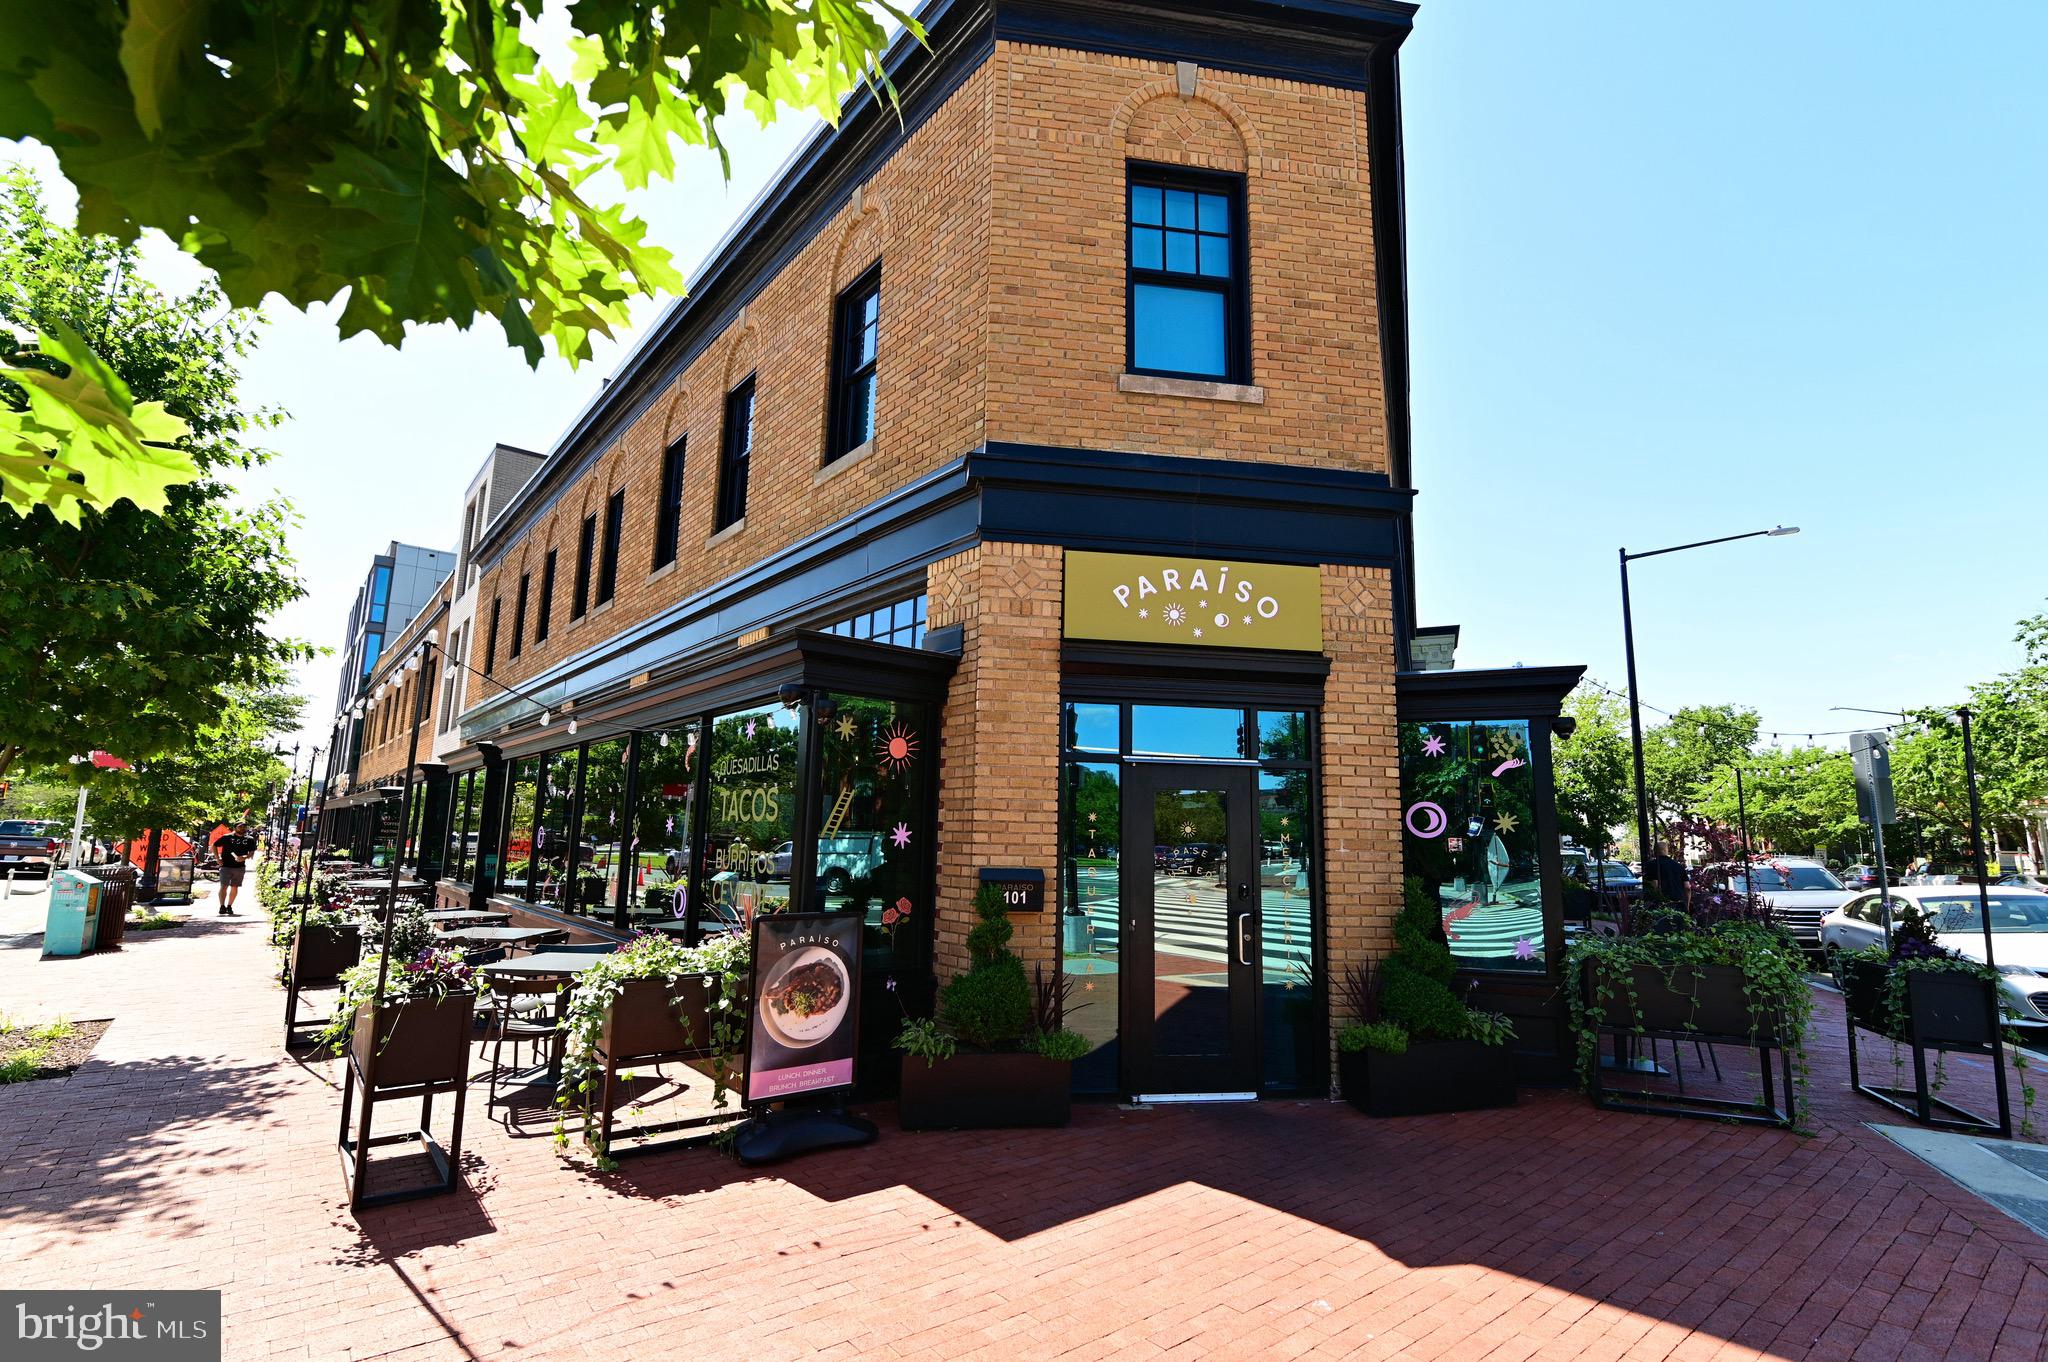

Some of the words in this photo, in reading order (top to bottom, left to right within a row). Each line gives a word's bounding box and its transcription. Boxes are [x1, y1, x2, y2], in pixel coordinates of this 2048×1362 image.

[720, 753, 780, 776] QUESADILLAS
[720, 787, 779, 822] TACOS
[141, 833, 169, 841] RD
[715, 848, 776, 876] BURRITOS
[1173, 846, 1209, 859] PASE
[1003, 890, 1026, 904] 101
[1086, 829, 1097, 973] TAQUERIA
[1280, 833, 1293, 974] MEZCALERIA
[778, 1072, 800, 1081] LUNCH
[803, 1067, 827, 1077] DINNER
[768, 1082, 797, 1092] BRUNCH
[799, 1076, 835, 1087] BREAKFAST
